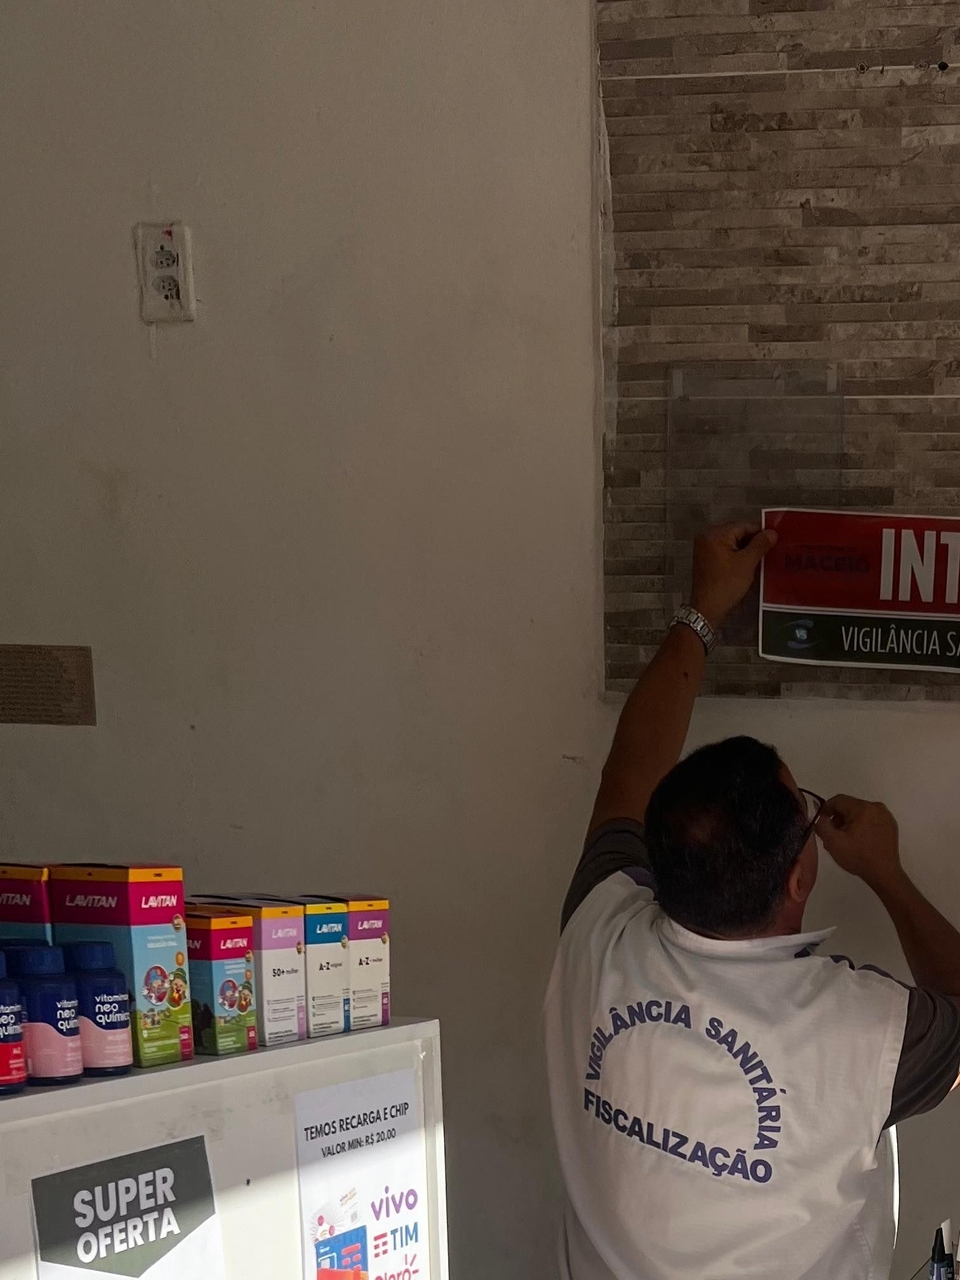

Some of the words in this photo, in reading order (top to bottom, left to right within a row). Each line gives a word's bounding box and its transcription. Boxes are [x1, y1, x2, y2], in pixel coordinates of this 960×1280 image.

[841, 624, 941, 656] VIGILÂNCIA
[65, 894, 118, 908] LAVITAN
[141, 894, 178, 909] LAVITAN
[272, 928, 298, 939] LAVITAN
[316, 923, 342, 934] LAVITAN
[357, 919, 383, 930] LAVITAN
[220, 938, 248, 950] LAVITAN
[57, 1009, 76, 1019] neo
[95, 1003, 119, 1013] neo
[585, 1000, 692, 1081] VIGILÂNCIA
[705, 1016, 786, 1151] SANITÁRIA
[304, 1120, 337, 1141] TEMOS
[339, 1109, 382, 1132] RECARGA
[383, 1107, 388, 1121] E
[389, 1102, 410, 1118] CHIP
[583, 1087, 773, 1184] FISCALIZAÇÃO
[321, 1141, 346, 1158] VALOR
[347, 1137, 364, 1151] MIN:
[365, 1132, 375, 1146] R$
[376, 1127, 397, 1143] 20,00
[73, 1167, 176, 1228] SUPER
[370, 1185, 418, 1221] vivo
[76, 1206, 181, 1264] OFERTA
[390, 1221, 419, 1251] TIM
